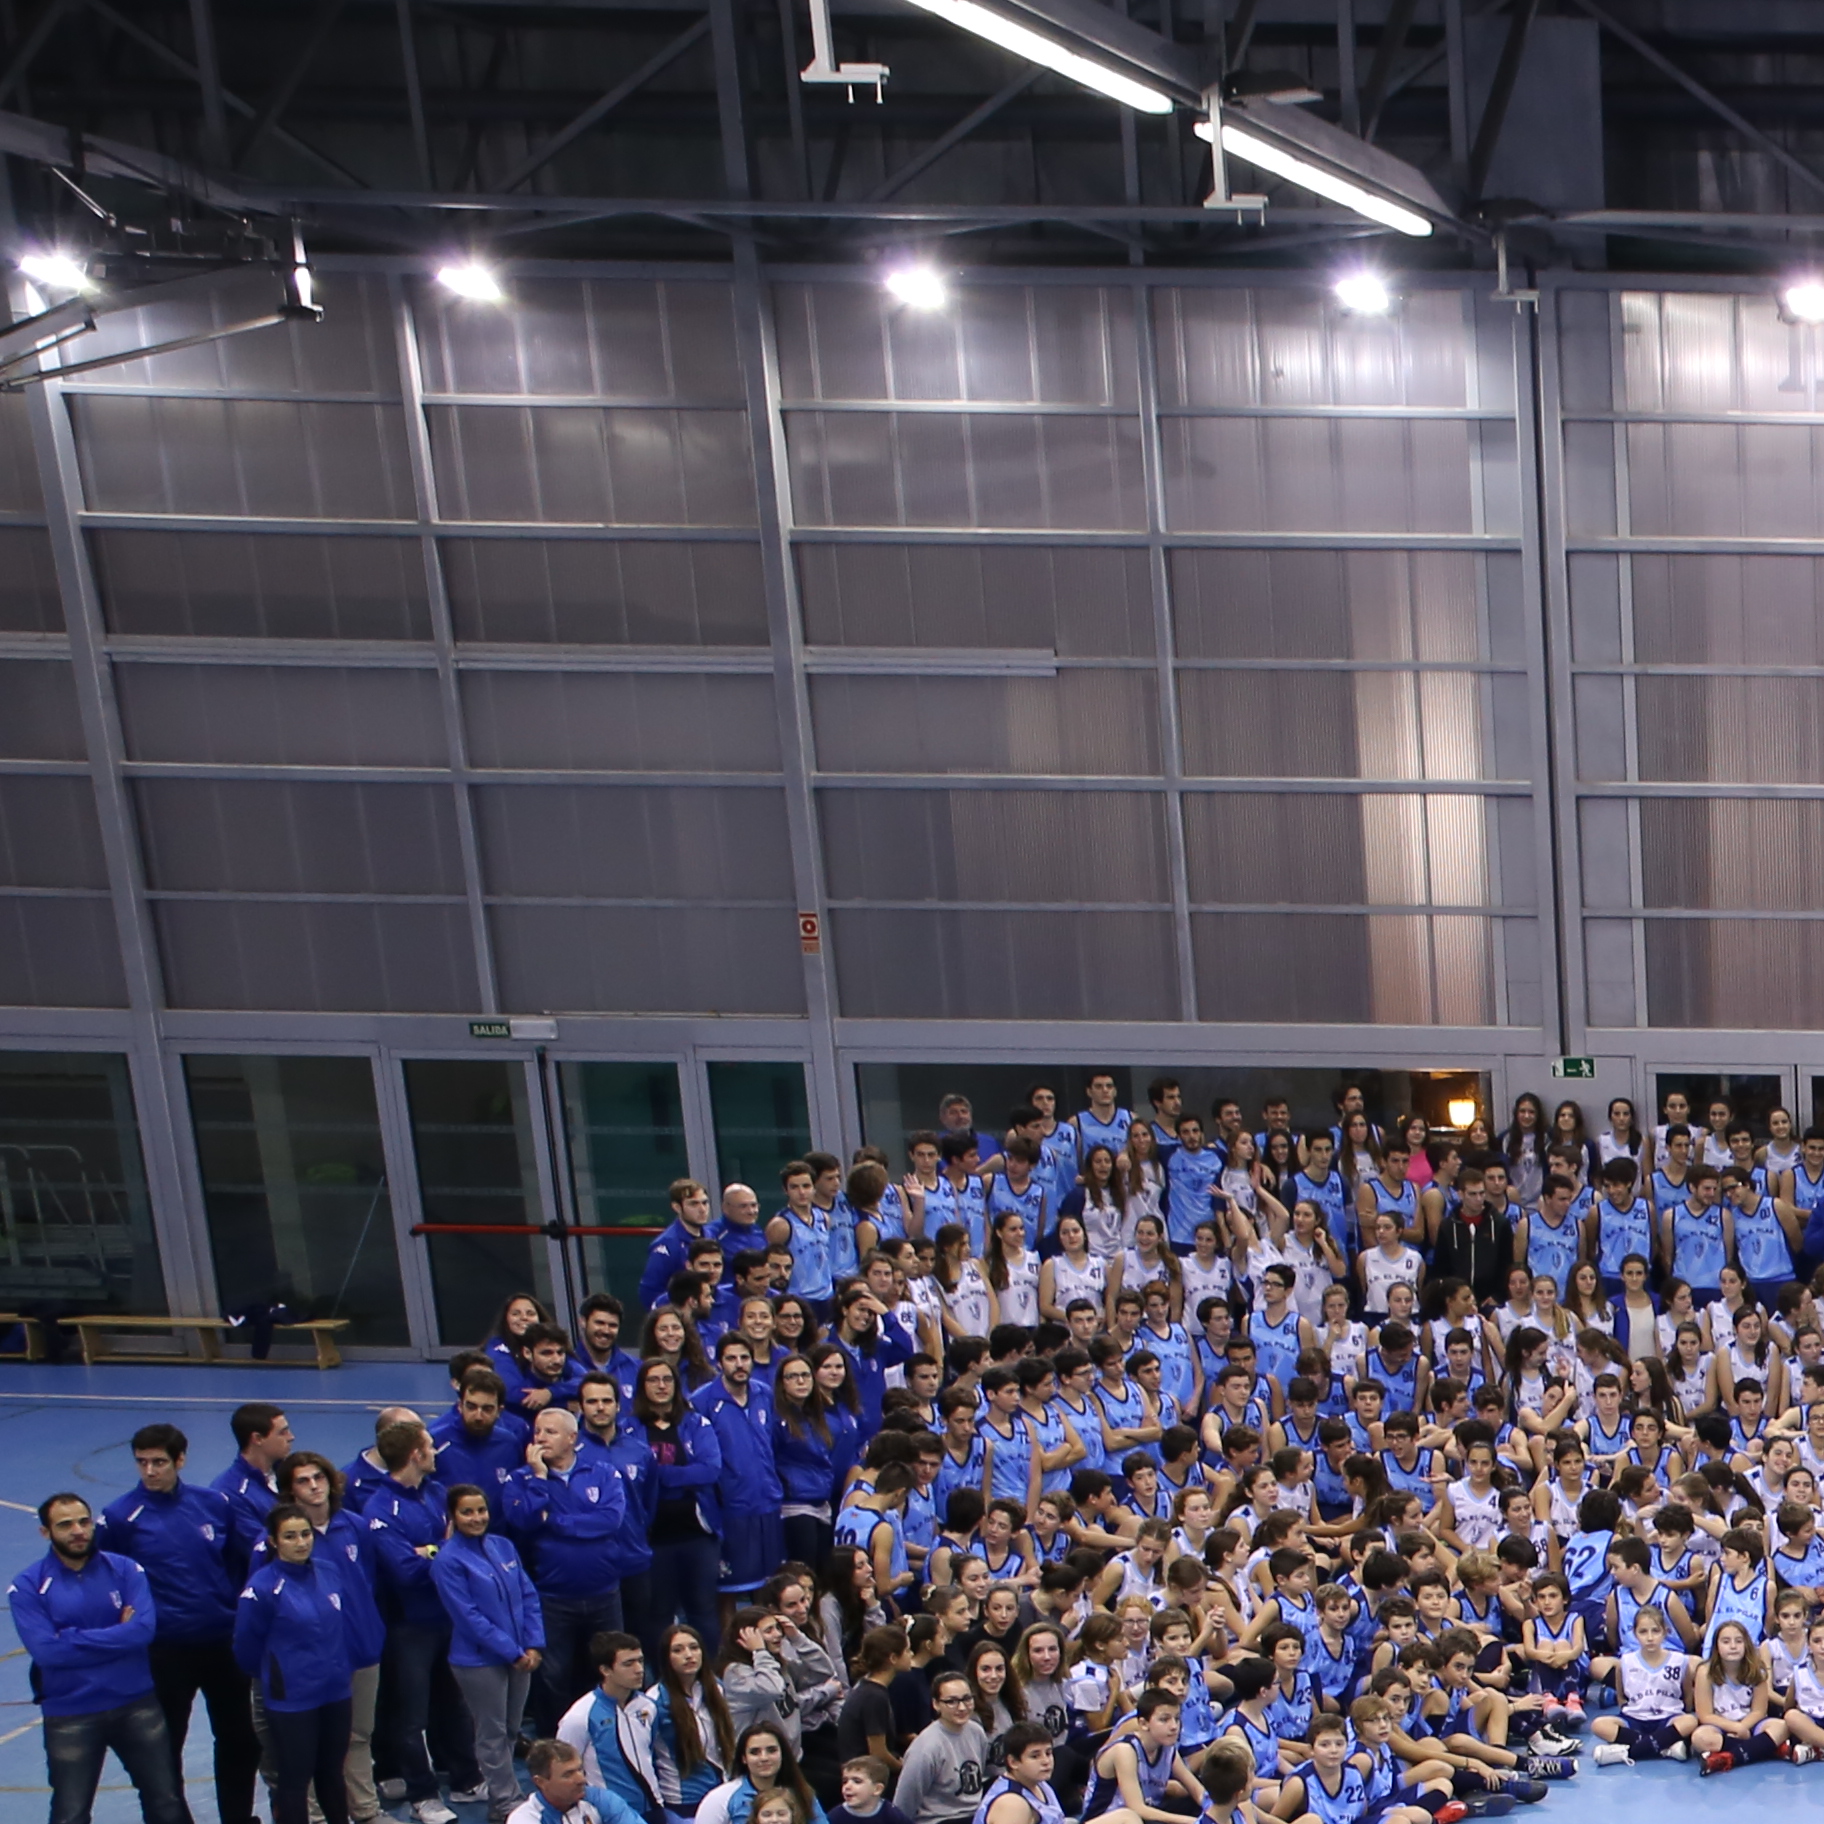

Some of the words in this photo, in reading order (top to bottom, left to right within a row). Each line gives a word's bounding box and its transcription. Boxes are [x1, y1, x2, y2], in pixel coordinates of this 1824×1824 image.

[473, 1024, 508, 1035] SALIDA
[1489, 1495, 1497, 1508] 4
[1562, 1545, 1597, 1578] 62
[1750, 1587, 1758, 1601] 6
[1663, 1666, 1681, 1680] 38
[1345, 1785, 1365, 1803] 22
